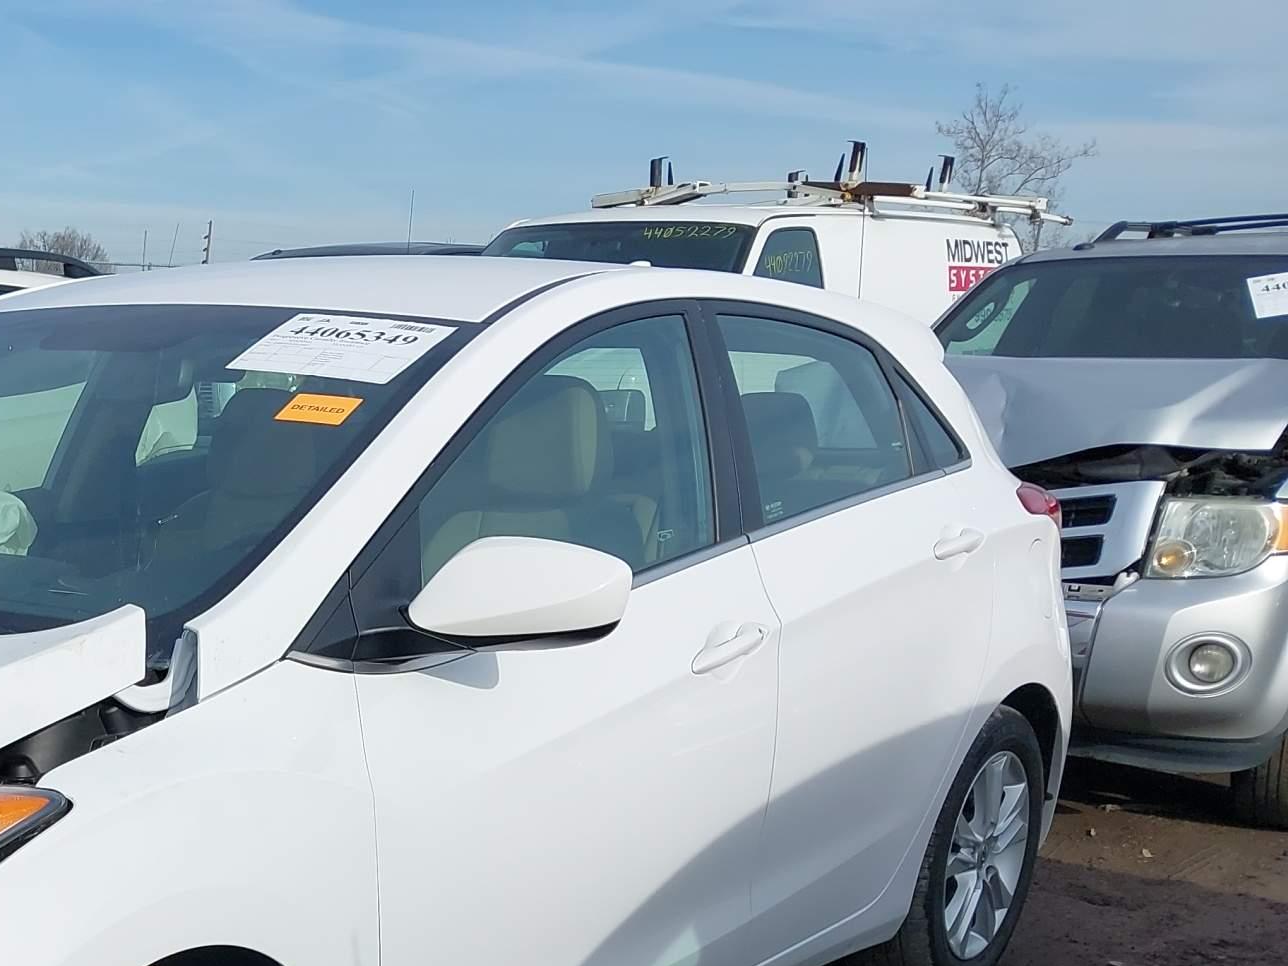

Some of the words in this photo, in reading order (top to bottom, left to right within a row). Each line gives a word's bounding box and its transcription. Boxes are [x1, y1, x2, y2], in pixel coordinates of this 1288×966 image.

[643, 225, 737, 240] 44052279
[945, 239, 1009, 264] MIDWEST
[290, 325, 419, 345] 44065349
[291, 403, 345, 414] DETAILED
